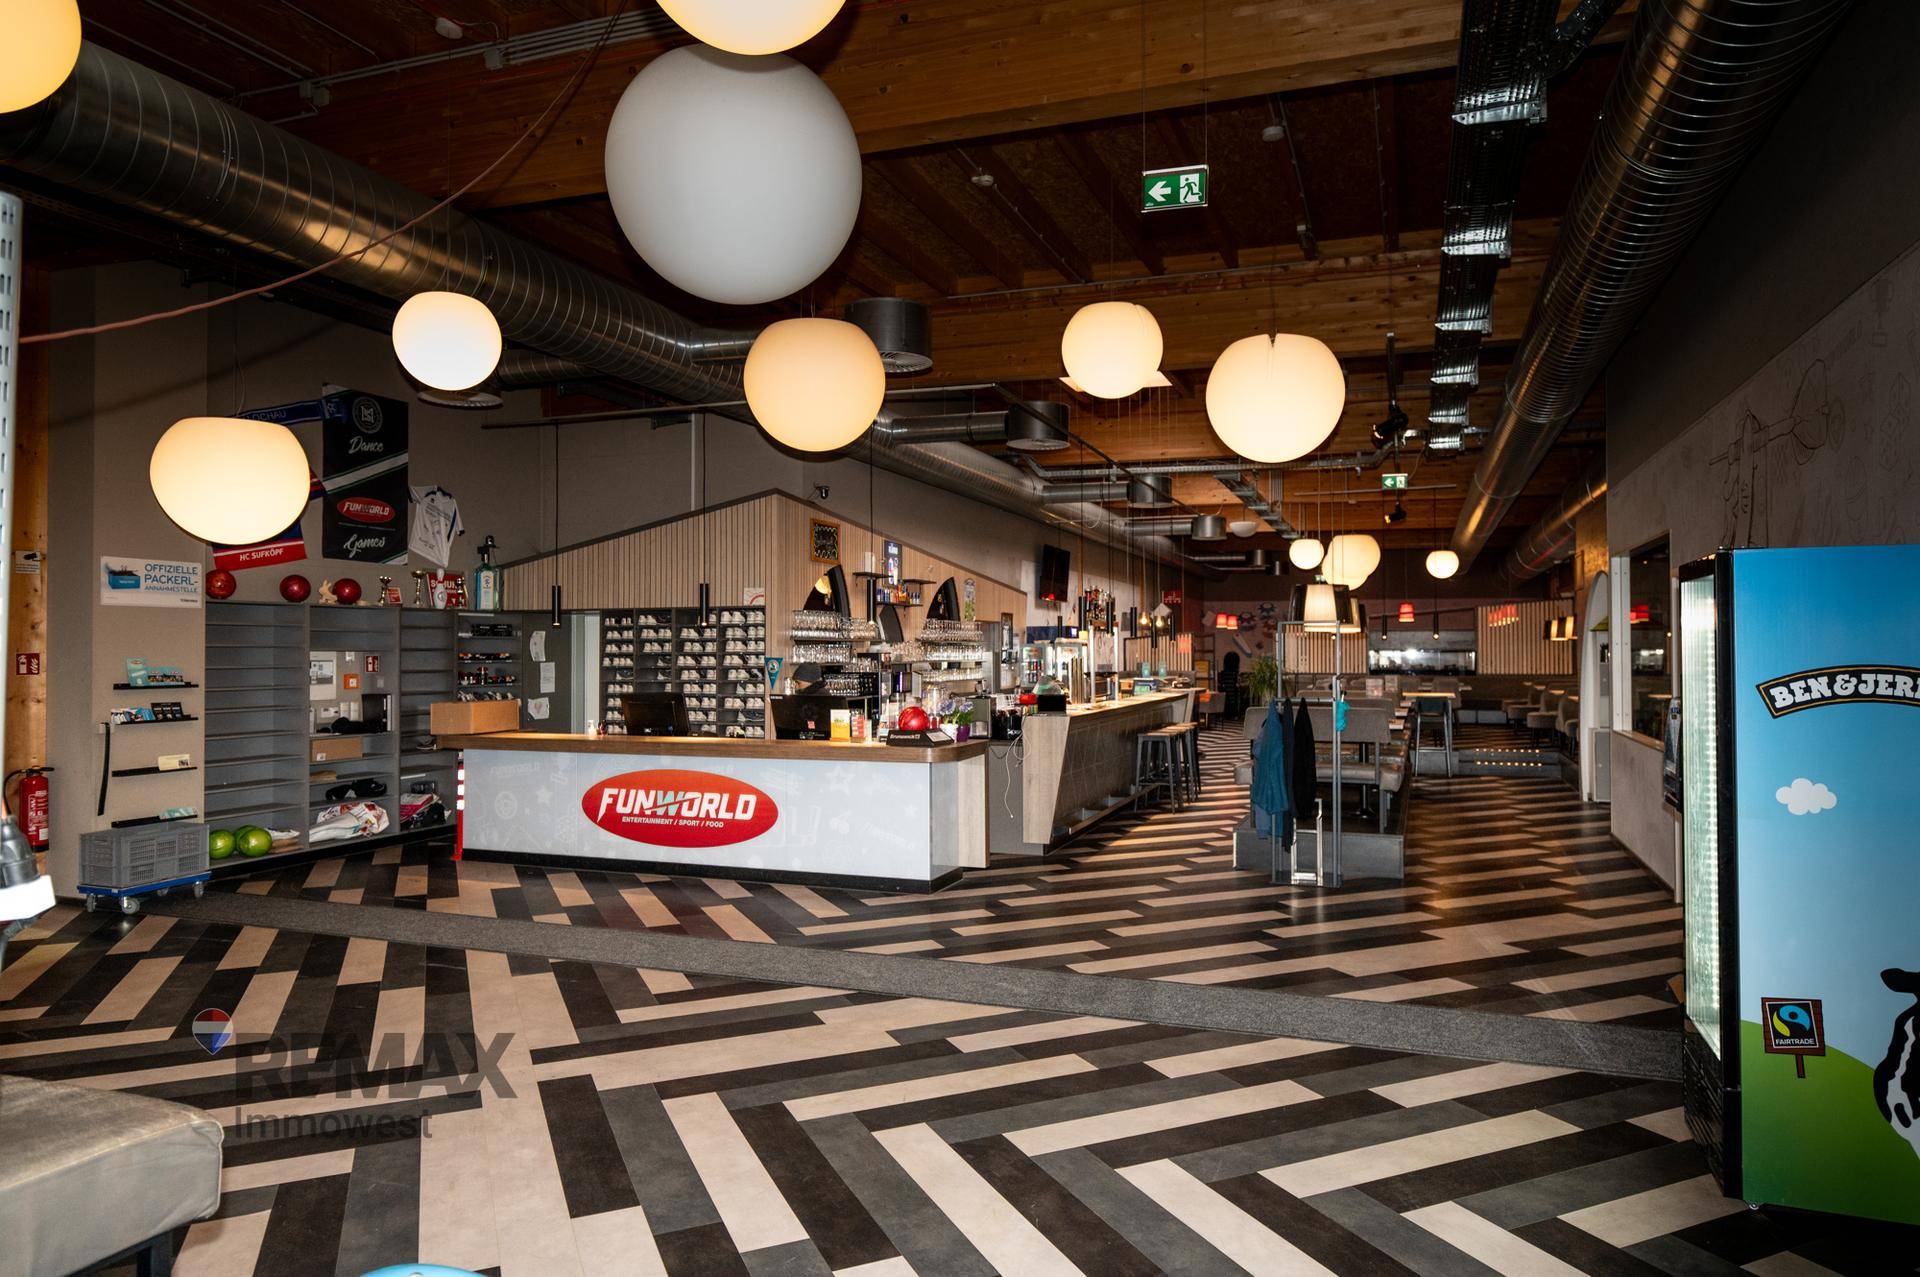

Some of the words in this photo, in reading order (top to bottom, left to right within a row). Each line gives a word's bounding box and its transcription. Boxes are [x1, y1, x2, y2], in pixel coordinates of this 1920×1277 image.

[348, 435, 384, 455] Dance
[342, 501, 390, 516] FUNWORLD
[343, 533, 386, 558] Games
[144, 563, 198, 575] OFFIZIELLE
[144, 573, 199, 586] PACKERL-
[144, 585, 198, 593] ANNAHMESTELLE
[597, 787, 757, 823] FUNWORLD
[621, 816, 673, 825] ENTERTAINMENT
[679, 819, 700, 827] SPORT
[705, 820, 724, 829] FOOD
